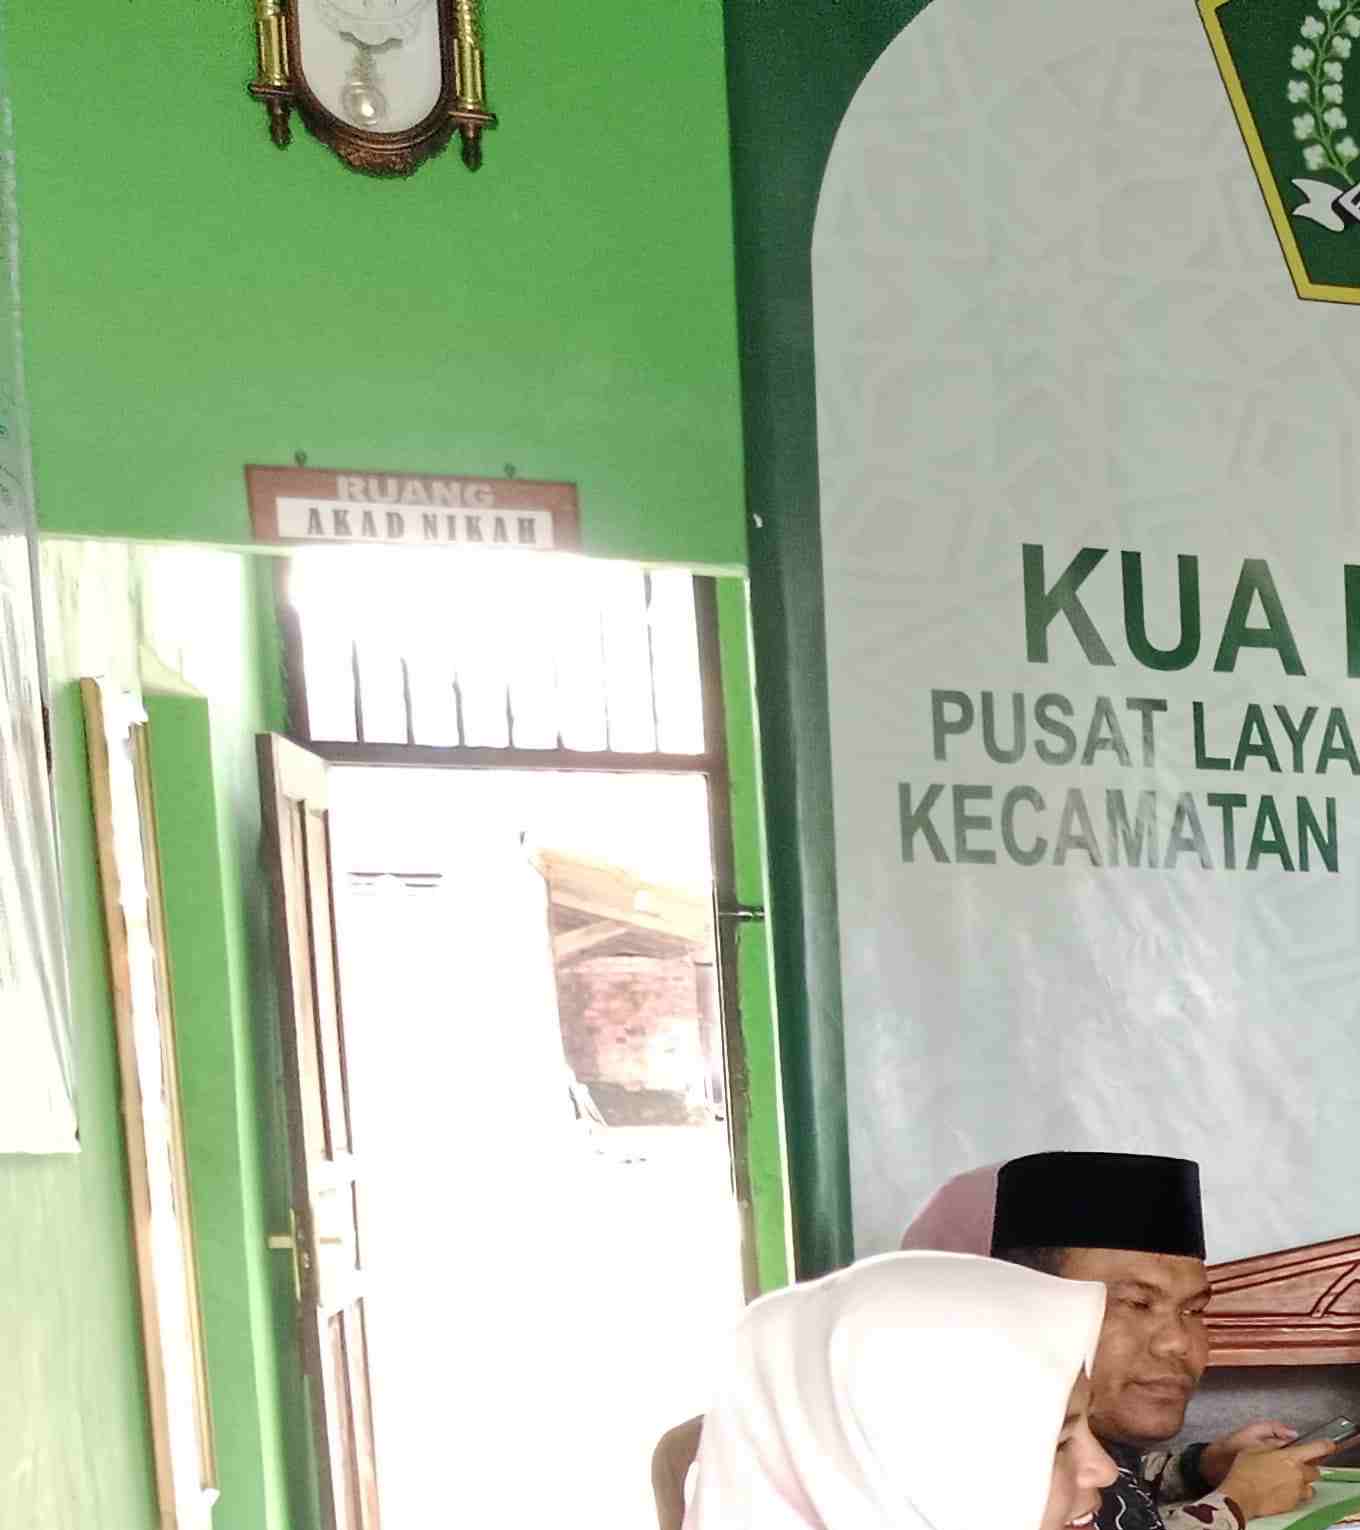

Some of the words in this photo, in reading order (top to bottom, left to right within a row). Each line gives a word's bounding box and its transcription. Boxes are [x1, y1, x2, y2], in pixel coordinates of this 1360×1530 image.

[307, 507, 405, 538] AKAD
[422, 512, 537, 544] NIKAH
[336, 474, 495, 508] RUANG
[1020, 543, 1306, 678] KUA
[929, 689, 1167, 768] PUSAT
[897, 782, 1340, 873] KECAMATAN
